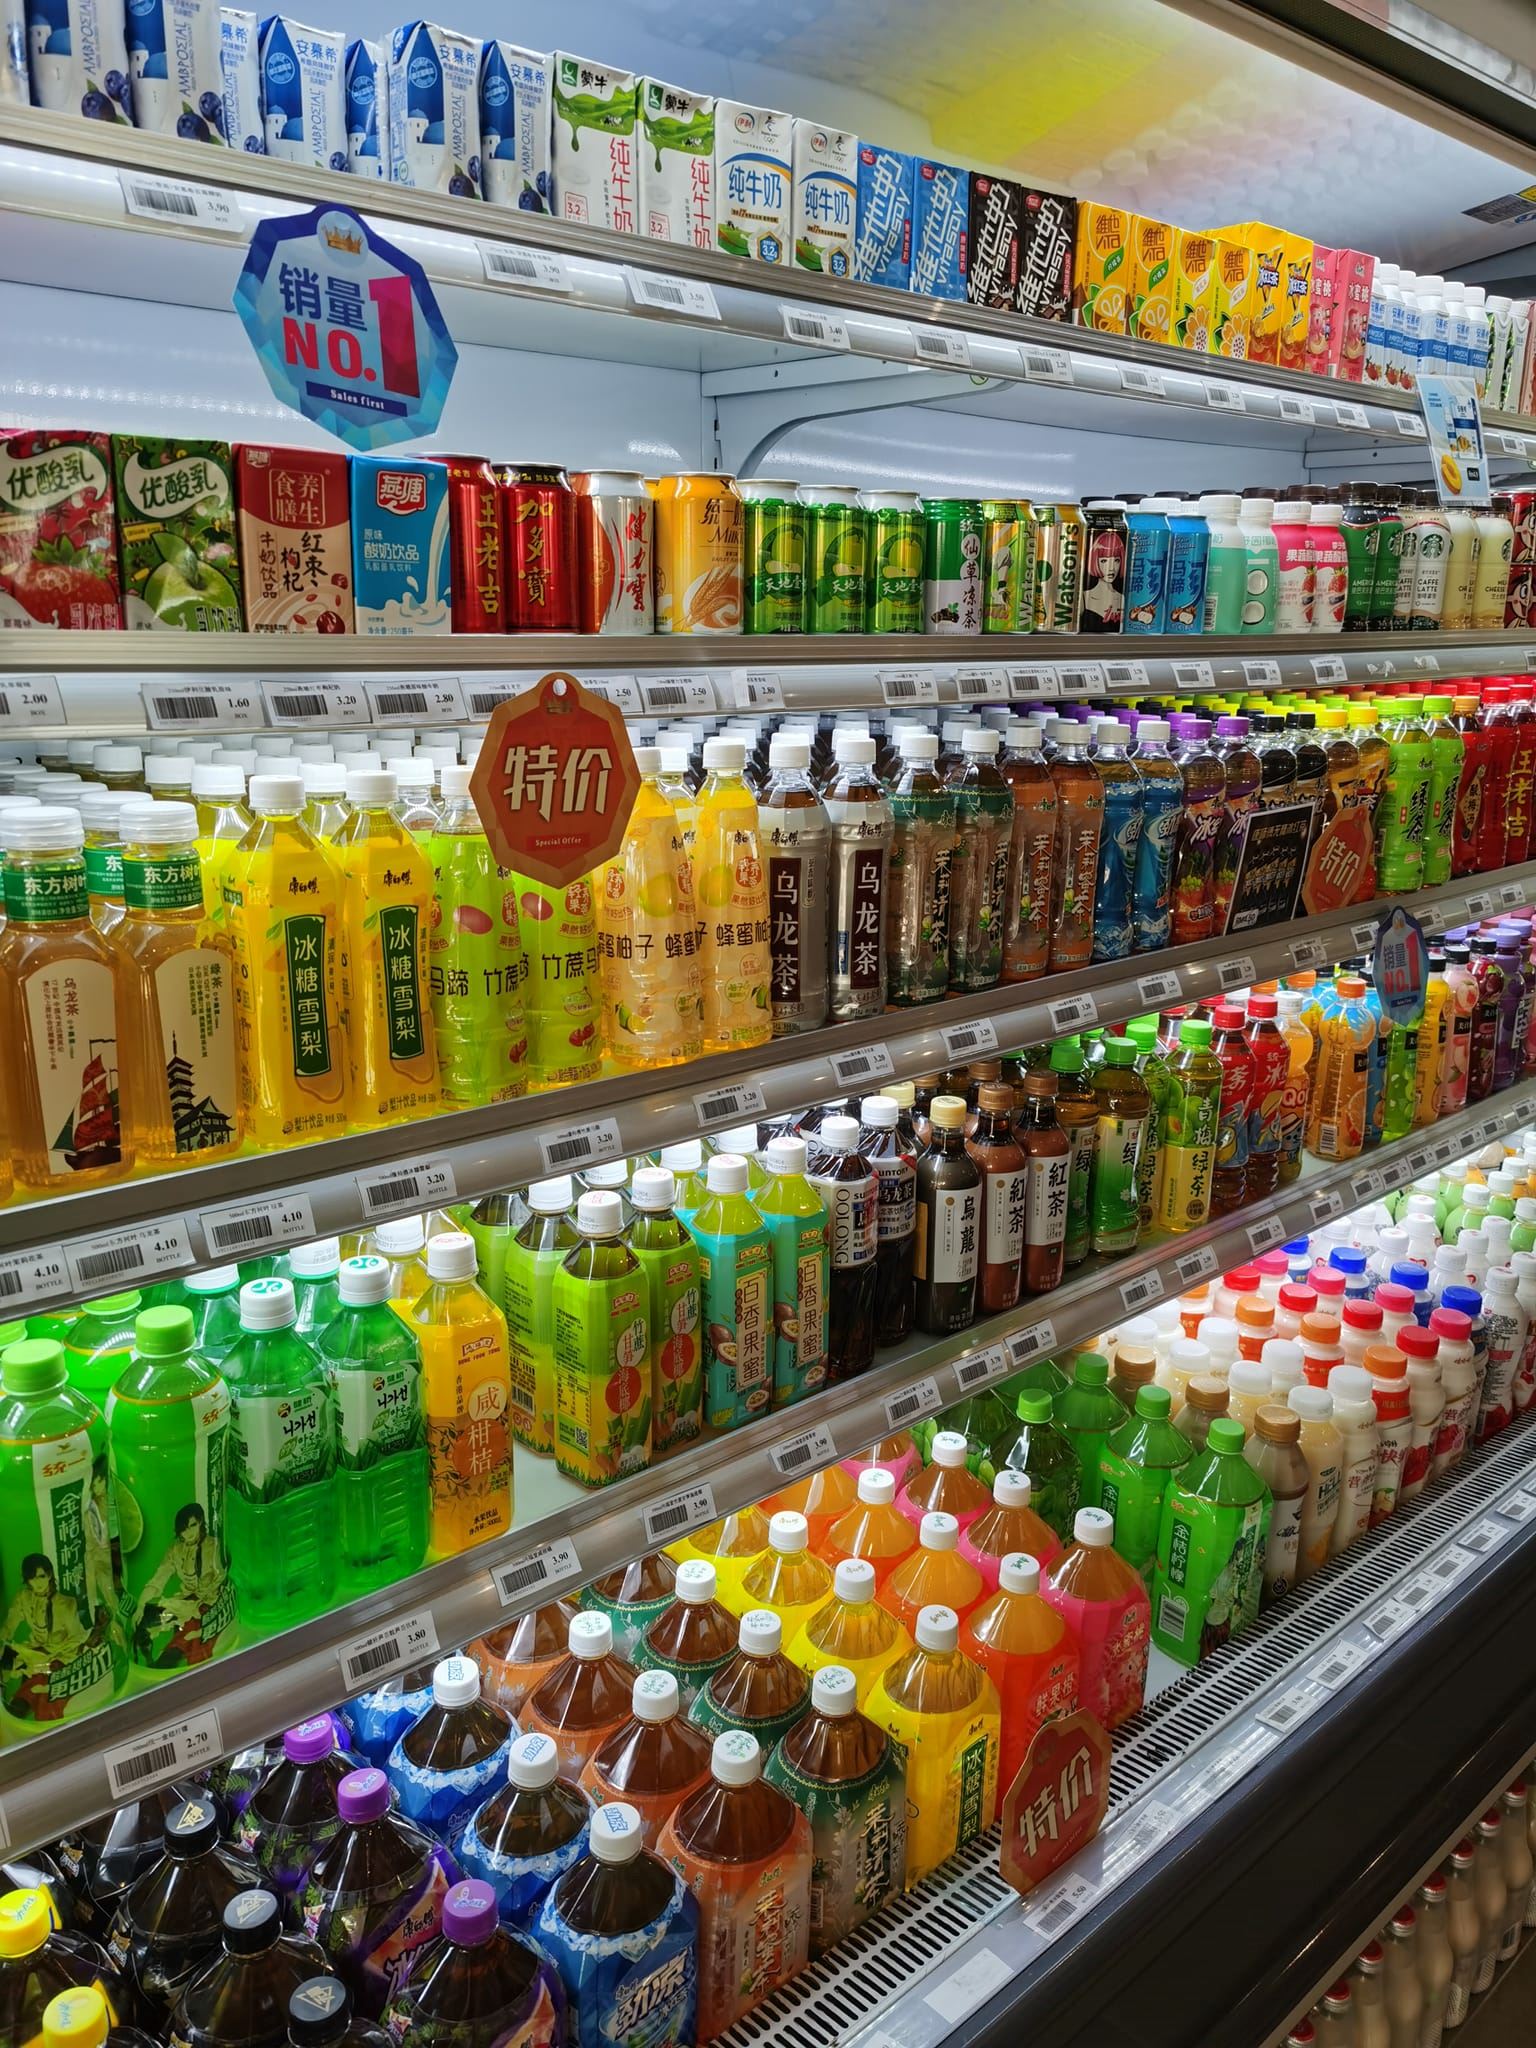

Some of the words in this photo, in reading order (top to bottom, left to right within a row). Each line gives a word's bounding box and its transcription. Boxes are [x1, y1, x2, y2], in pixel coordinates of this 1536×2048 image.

[295, 39, 337, 63] 安慕希
[439, 44, 477, 68] 安慕希
[511, 63, 546, 87] 安慕希
[729, 164, 782, 209] 纯牛奶
[805, 182, 850, 225] 纯牛奶
[278, 262, 368, 332] 销量
[330, 389, 358, 404] Sales
[361, 397, 385, 410] first
[7, 452, 94, 500] 优酸乳
[140, 461, 217, 509] 优酸乳
[380, 475, 424, 504] 燕塘
[364, 528, 383, 541] 原味
[364, 543, 420, 561] 酸奶饮品
[258, 532, 278, 599] 牛奶饮品
[280, 547, 304, 593] 枸杞
[301, 532, 328, 587] 红枣
[475, 493, 501, 614] 王老吉
[1019, 520, 1038, 627] Watson's
[1053, 524, 1079, 626] Watson's
[22, 693, 48, 705] 2.00
[228, 698, 250, 708] 1.60
[336, 695, 357, 706] 3.20
[435, 694, 454, 704] 2.80
[615, 688, 631, 697] 2.50
[692, 687, 706, 696] 2.50
[503, 744, 613, 823] 特价
[1508, 749, 1534, 837] 王老吉
[535, 838, 560, 847] Special
[561, 836, 582, 845] Offer
[1320, 835, 1360, 893] 特价
[773, 871, 799, 991] 乌龙茶
[854, 862, 880, 976] 乌龙茶
[1383, 943, 1405, 970] 销量
[210, 963, 223, 989] 绿茶
[388, 924, 416, 1041] 冰糖雪梨
[64, 977, 79, 1017] 乌龙茶
[294, 936, 322, 1057] 冰糖雪梨
[597, 1132, 613, 1144] 3.20
[1193, 1096, 1215, 1146] 青梅
[427, 1173, 445, 1186] 3.20
[428, 1186, 448, 1196] BOTTLE
[1047, 1162, 1069, 1218] 紅茶
[1190, 1151, 1209, 1198] 绿茶
[281, 1211, 302, 1224] 4.10
[1009, 1177, 1025, 1234] 紅茶
[282, 1225, 305, 1235] BOTTLE
[835, 1188, 850, 1264] OOLONG
[960, 1196, 976, 1255] 烏龍
[154, 1237, 178, 1252] 4.10
[156, 1252, 182, 1264] BOTTLE
[34, 1263, 59, 1278] 4.10
[35, 1279, 63, 1291] BOTTLE
[686, 1287, 698, 1319] 竹蔗
[802, 1258, 818, 1358] 百香果蜜
[632, 1318, 646, 1351] 竹蔗
[742, 1279, 760, 1382] 百香果蜜
[693, 1498, 708, 1511] 3.90
[55, 1491, 84, 1593] 金桔柠檬
[552, 1551, 569, 1565] 3.90
[1172, 1522, 1187, 1586] 金桔柠檬
[408, 1629, 426, 1645] 3.80
[186, 1731, 208, 1749] 2.70
[961, 1747, 982, 1840] 冰糖雪梨
[1018, 1744, 1093, 1860] 特价
